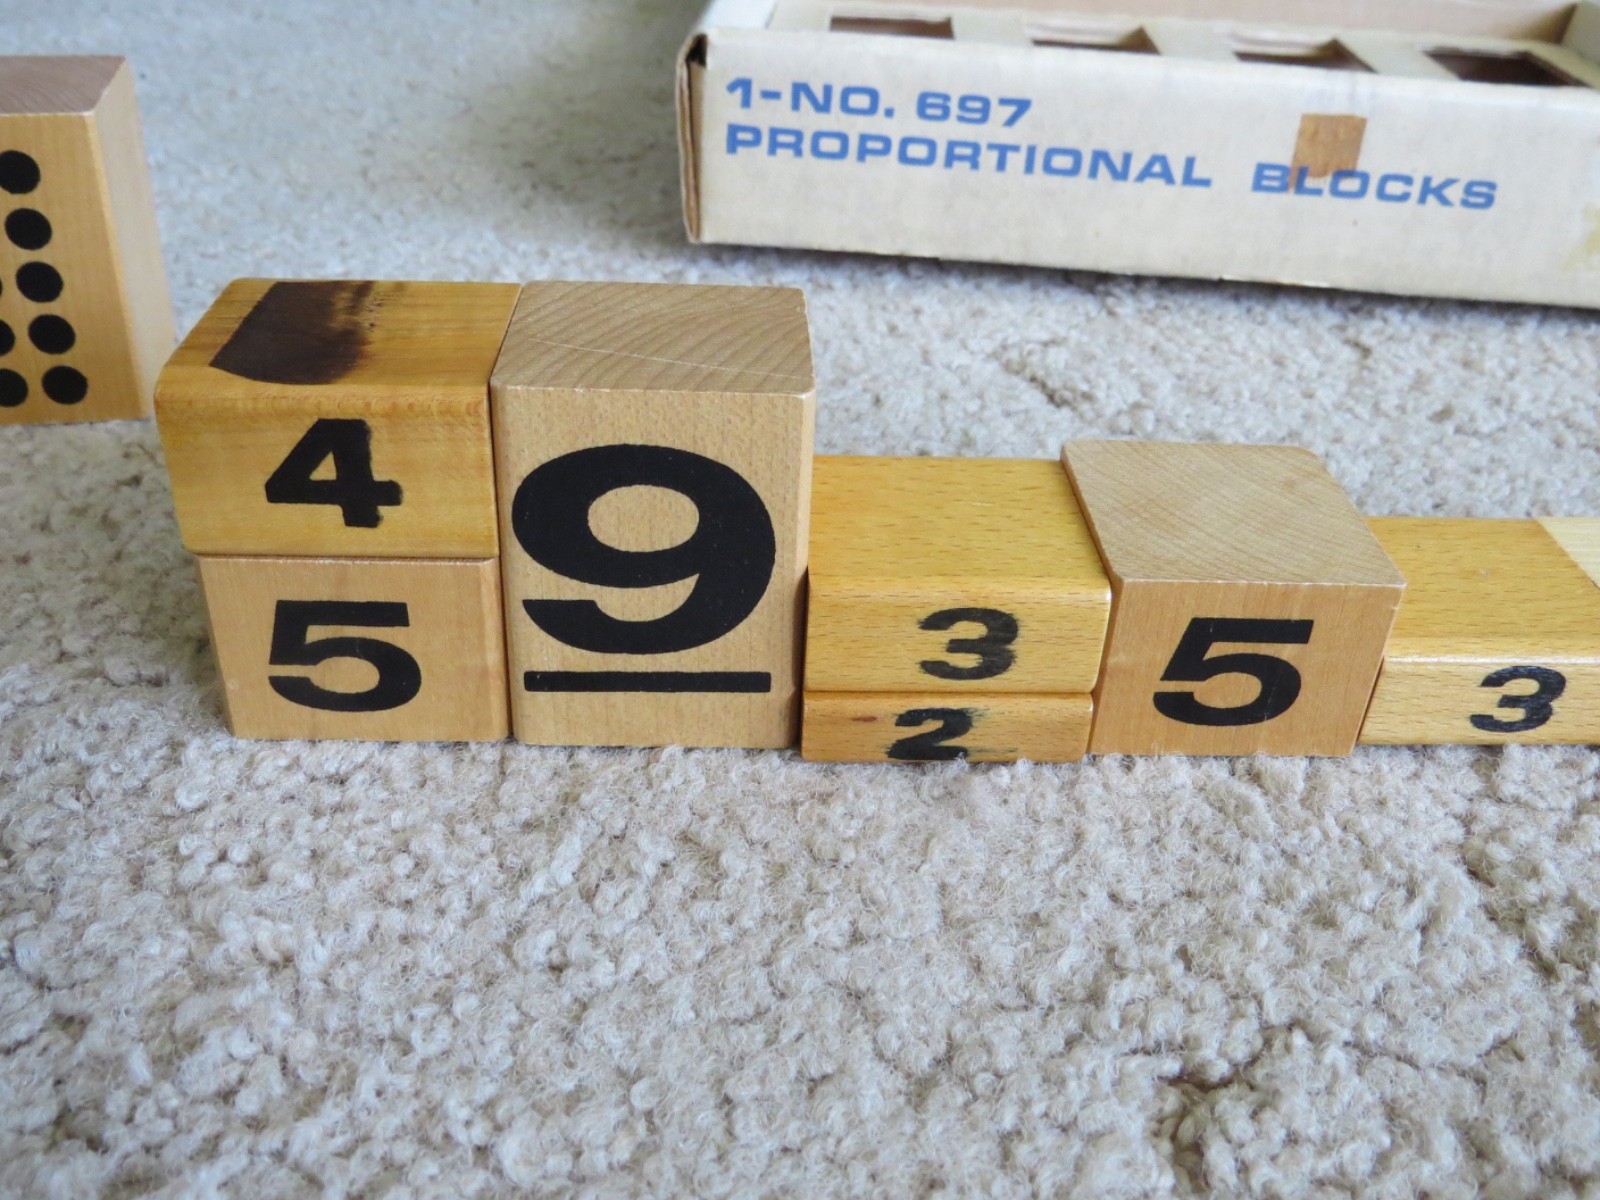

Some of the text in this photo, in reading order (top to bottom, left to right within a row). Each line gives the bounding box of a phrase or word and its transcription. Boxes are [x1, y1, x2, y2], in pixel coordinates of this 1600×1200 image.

[726, 77, 1033, 128] 1-NO. 697
[726, 122, 1499, 210] PROPORTIONAL BLOCKS
[264, 418, 403, 529] 4
[511, 443, 777, 656] 9
[268, 599, 422, 713] 5
[919, 607, 1019, 680] 3
[1153, 616, 1314, 727] 5
[885, 707, 975, 762] 2
[1469, 665, 1567, 733] 3
